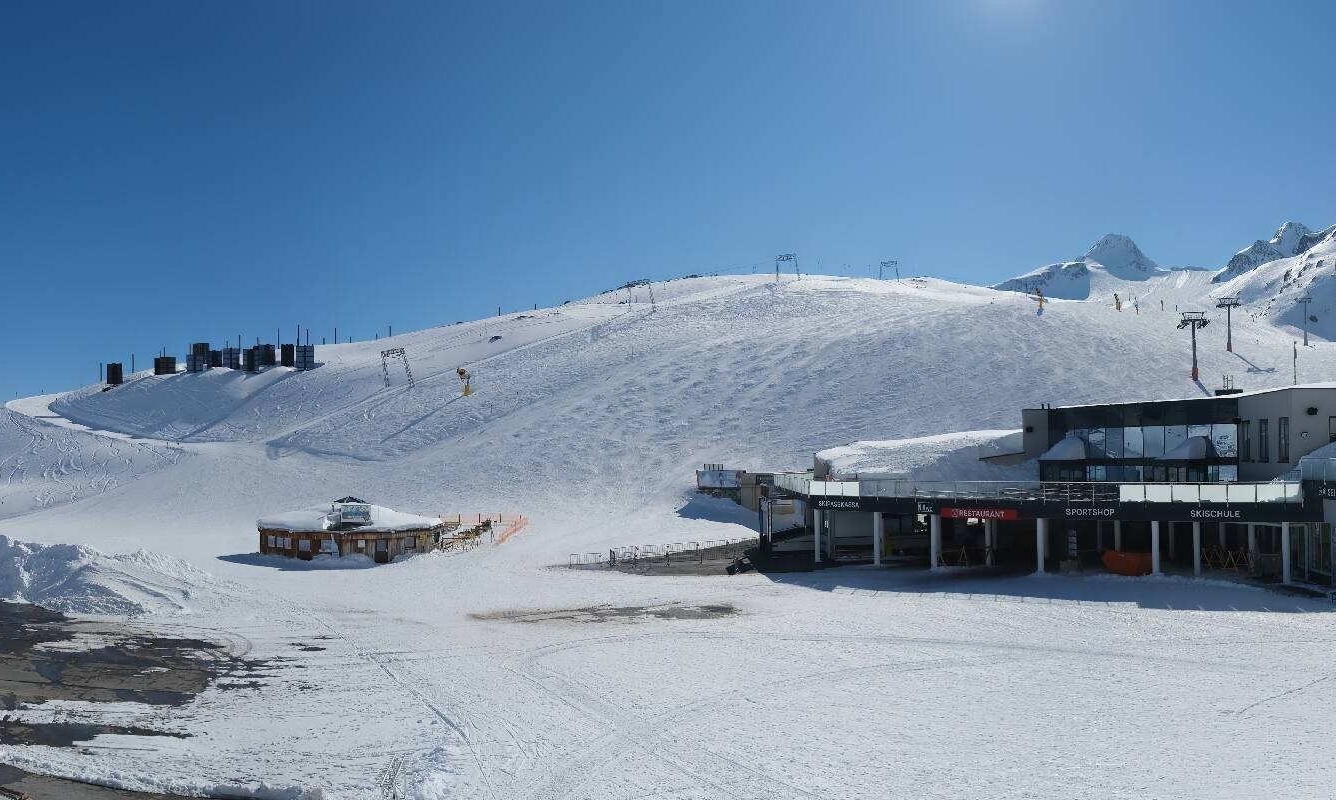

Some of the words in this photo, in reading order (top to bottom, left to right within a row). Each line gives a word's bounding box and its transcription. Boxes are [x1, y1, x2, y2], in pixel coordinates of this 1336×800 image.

[959, 509, 1005, 518] RESTAURANT
[1065, 508, 1115, 517] SPORTSHOP
[1190, 509, 1241, 518] SKISCHULE
